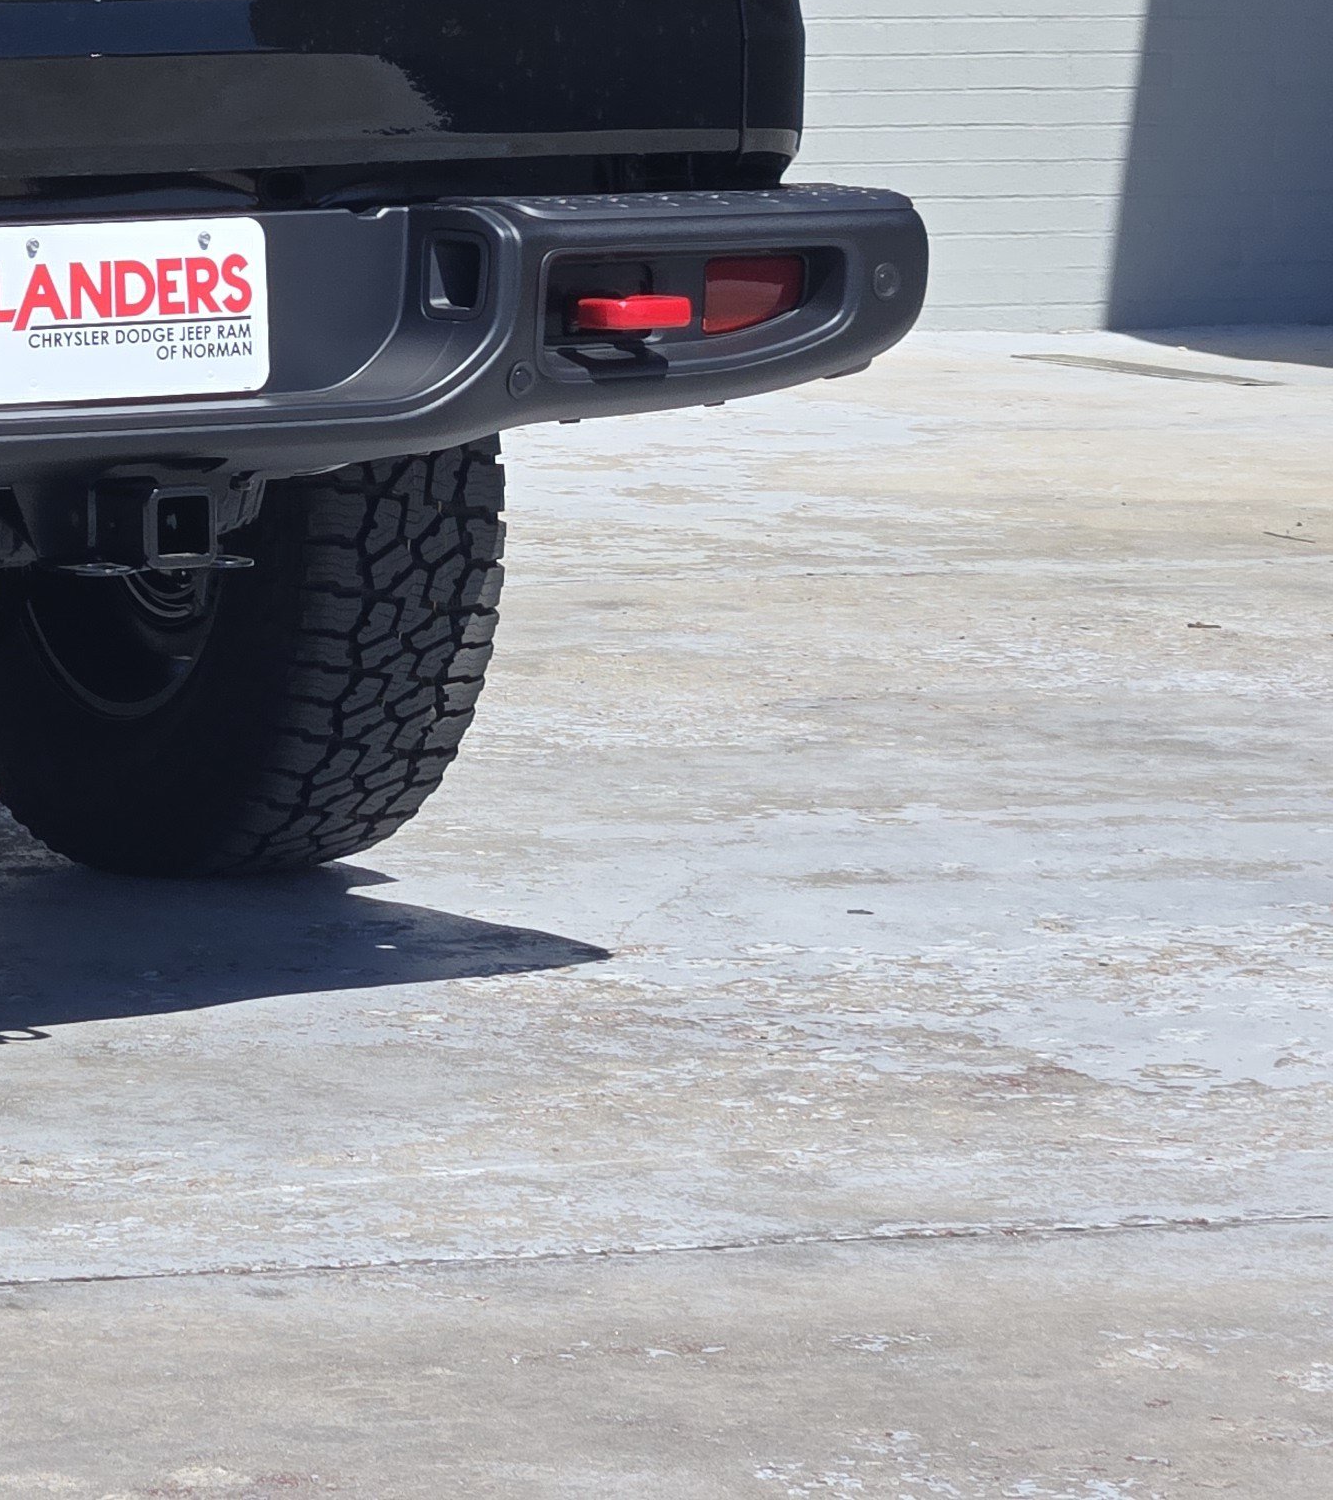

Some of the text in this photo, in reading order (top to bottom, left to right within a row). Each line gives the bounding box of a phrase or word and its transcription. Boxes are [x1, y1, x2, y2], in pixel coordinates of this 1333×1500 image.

[28, 323, 253, 349] CHRYSLER DODGE JEEP RAM
[156, 341, 253, 361] OF NORMAN
